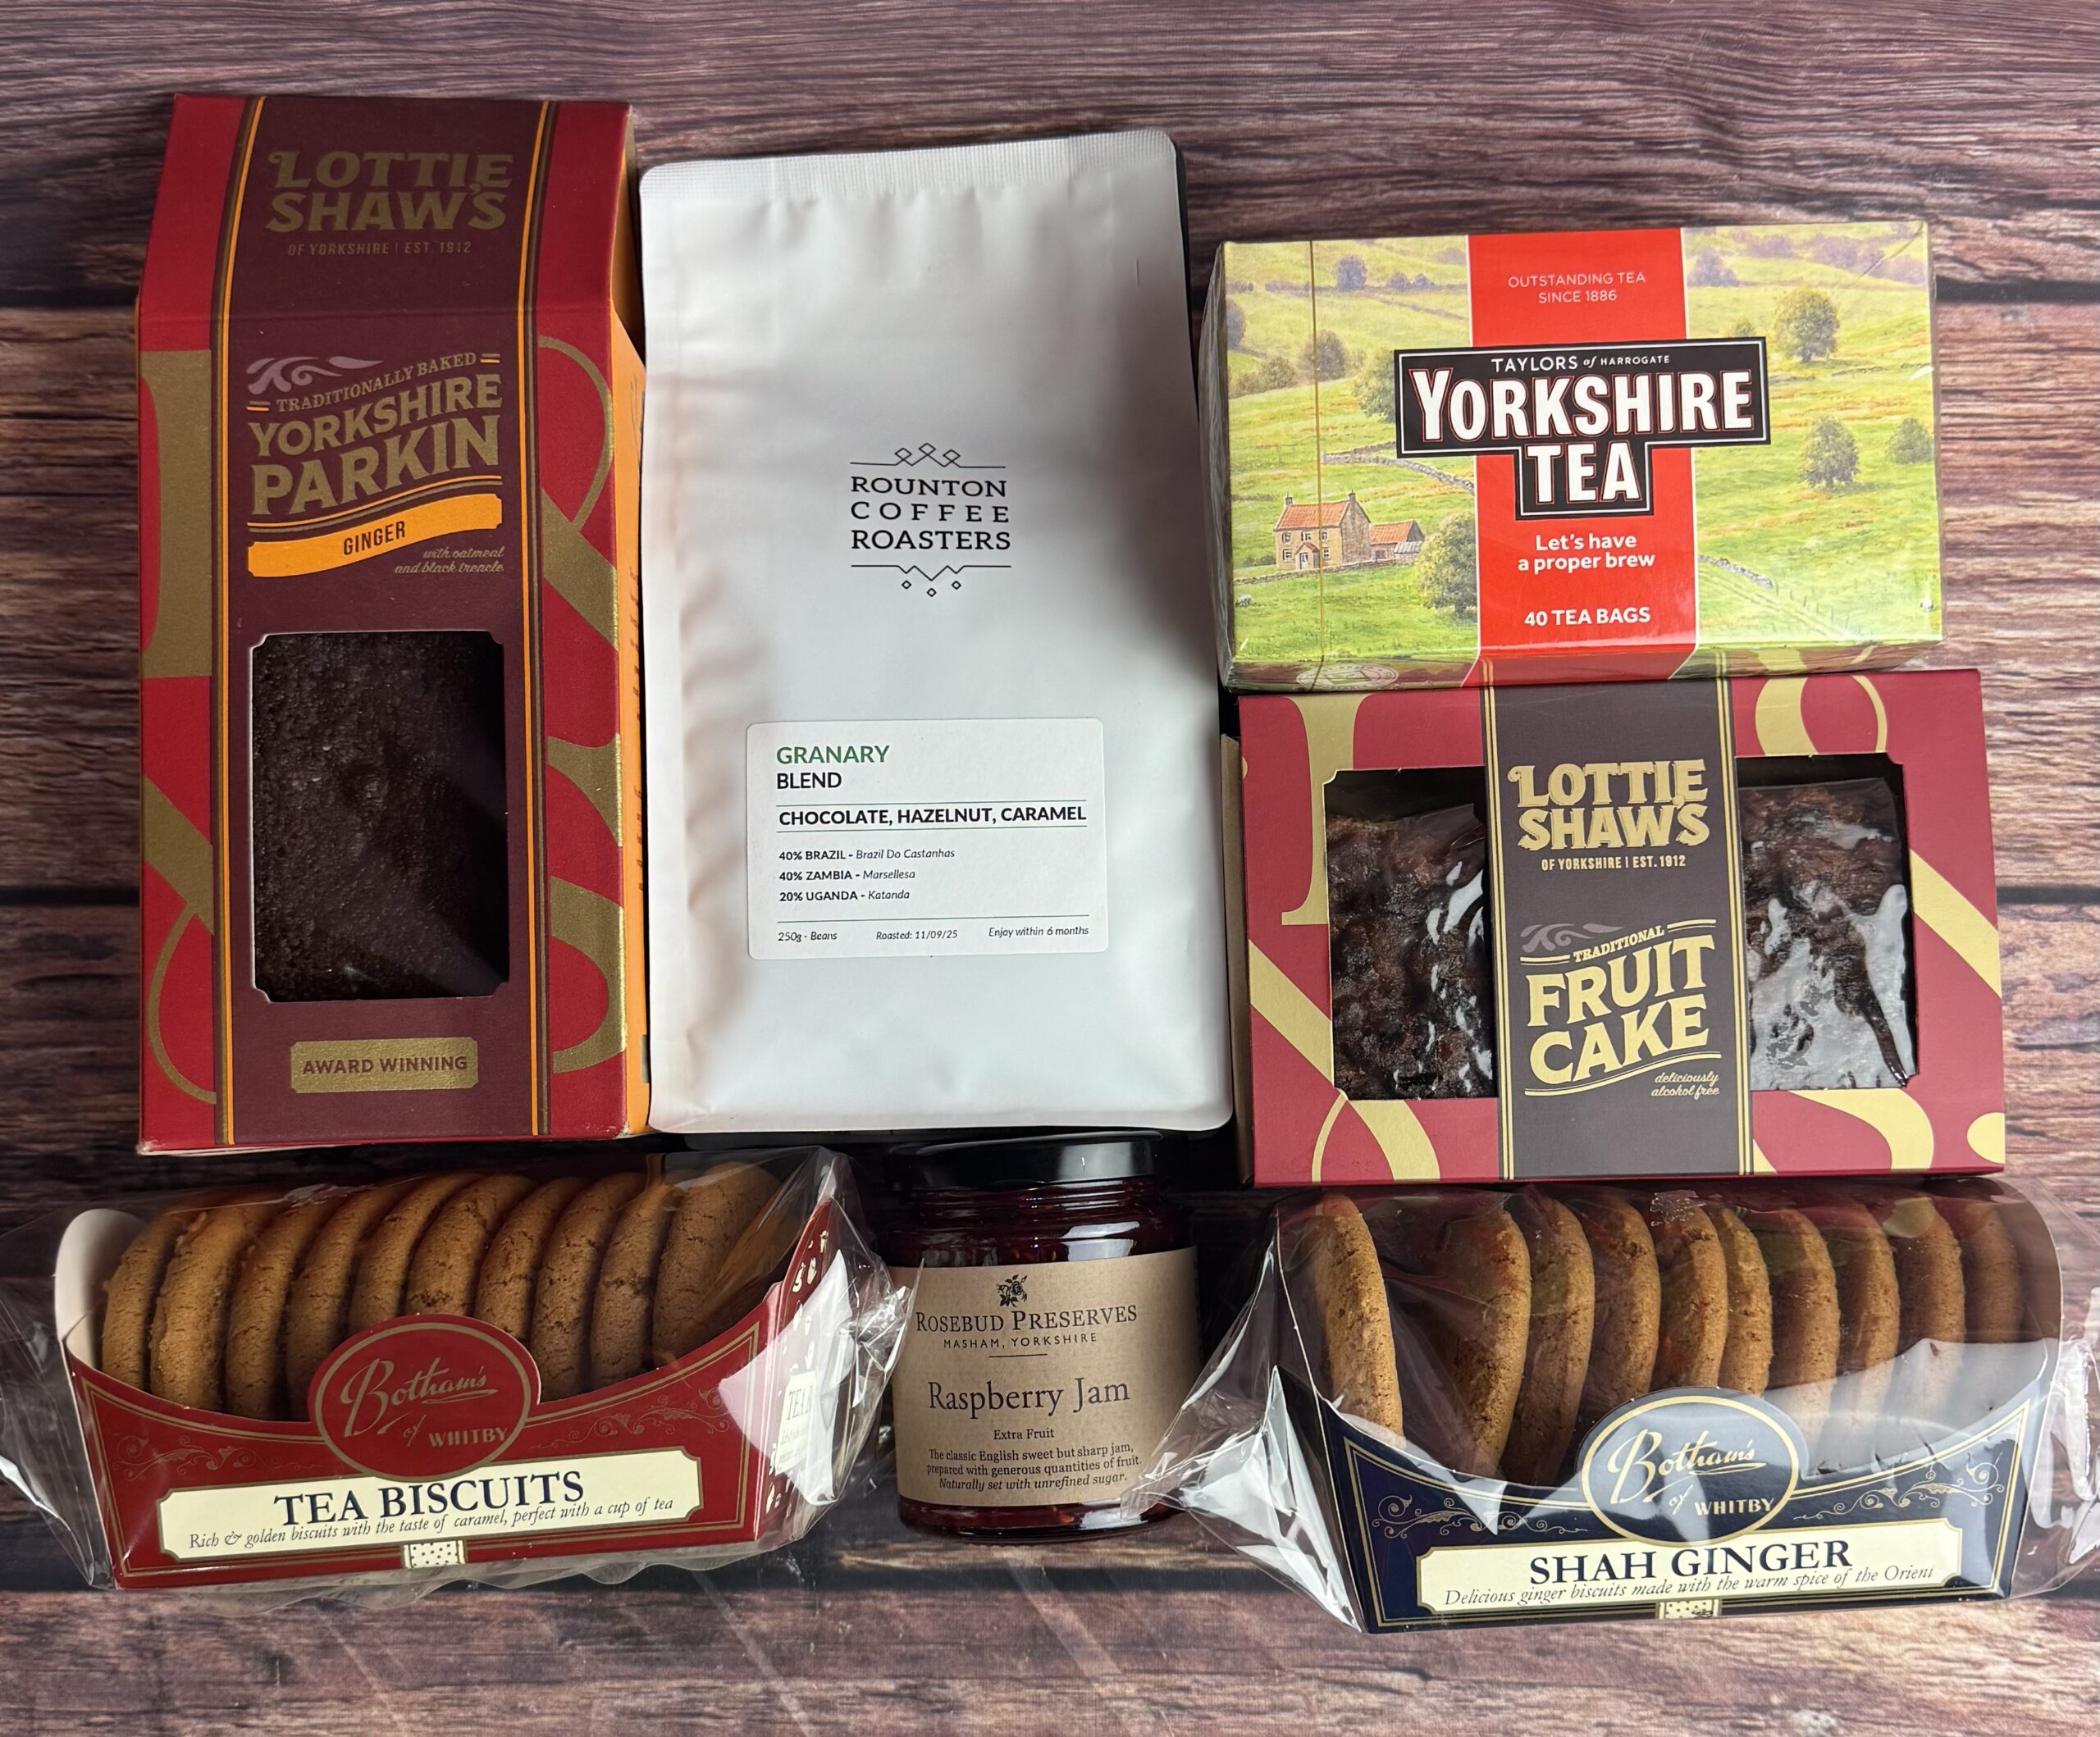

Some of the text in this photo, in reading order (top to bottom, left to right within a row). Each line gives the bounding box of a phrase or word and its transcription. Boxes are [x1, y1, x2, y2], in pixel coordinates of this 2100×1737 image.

[267, 150, 514, 189] LOTTIE
[264, 183, 508, 233] SHAW'S
[288, 241, 472, 256] OF YORKSHIRE EST. 1912
[1508, 271, 1646, 289] OUTSTANDING TEA
[1538, 290, 1618, 304] SINCE 1886
[1491, 354, 1670, 373] TAYLORS of HARROGATE
[276, 352, 477, 413] TRADITIONALLY BAKED
[1408, 367, 1754, 442] YORKSHIRE
[248, 374, 503, 457] YORKSHIRE
[251, 415, 500, 515] PARKIN
[1525, 440, 1642, 504] TEA
[851, 476, 1007, 497] ROUNTON
[851, 501, 1009, 522] COFFEE
[343, 521, 406, 556] GINGER
[851, 530, 1011, 550] ROASTERS
[1536, 533, 1637, 551] Let's have
[423, 546, 504, 558] with oatmeal
[395, 561, 504, 573] and black treacle
[1518, 552, 1655, 575] a proper brew
[1524, 606, 1650, 627] 40 TEA BAGS
[776, 745, 890, 764] GRANARY
[777, 773, 842, 789] BLEND
[1508, 759, 1708, 808] LOTTIE
[778, 806, 1087, 827] CHOCOLATE, HAZELNUT, CARAMEL
[1518, 794, 1710, 851] SHAW'S
[778, 851, 802, 860] 40%
[806, 850, 846, 860] BRAZIL
[856, 849, 883, 859] Brazil
[887, 850, 901, 859] Do
[904, 849, 955, 859] Castanhas
[1541, 855, 1686, 871] OF YORKSHIRE EST. 1912
[778, 871, 803, 881] 40%
[806, 870, 852, 880] ZAMBIA
[863, 869, 915, 879] Marsellesa
[779, 891, 803, 901] 20%
[806, 891, 858, 900] UGANDA
[868, 890, 910, 900] Katanda
[778, 932, 802, 942] 250g
[810, 932, 838, 941] Beans
[876, 930, 958, 941] Roasted: 11/09/25
[988, 927, 1089, 938] Enjoy within 6 months
[1573, 925, 1664, 963] TRADITIONAL
[1526, 934, 1715, 1027] FRUIT
[1530, 994, 1709, 1085] CAKE
[302, 1055, 468, 1075] AWARD WINNING
[1655, 1071, 1719, 1087] deliciously
[1651, 1085, 1719, 1100] alcohol free
[916, 1305, 1137, 1332] ROSEBUD PRESERVES
[943, 1333, 1098, 1349] MASHAM, YORKSHIRE
[340, 1357, 487, 1438] Botham's
[928, 1377, 1130, 1420] Raspberry Jam
[403, 1415, 508, 1448] of WHITBY
[993, 1428, 1055, 1440] Extra Fruit
[929, 1443, 1134, 1463] The classic English sweet but sharp jam,
[927, 1455, 1142, 1478] prepared with generous quantities of fruit.
[1607, 1429, 1755, 1504] Botham's
[939, 1472, 1127, 1492] Naturally set with unrefined sugar.
[273, 1470, 584, 1526] TEA BISCUITS
[1669, 1484, 1774, 1516] of WHITBY
[189, 1497, 673, 1548] Rich & golden biscuits with the taste of caramel, perfect with a cup of tea
[1530, 1540, 1852, 1584] SHAH GINGER
[1445, 1565, 1936, 1606] Delicious ginger biscuits made with the warm spice of the Orient
